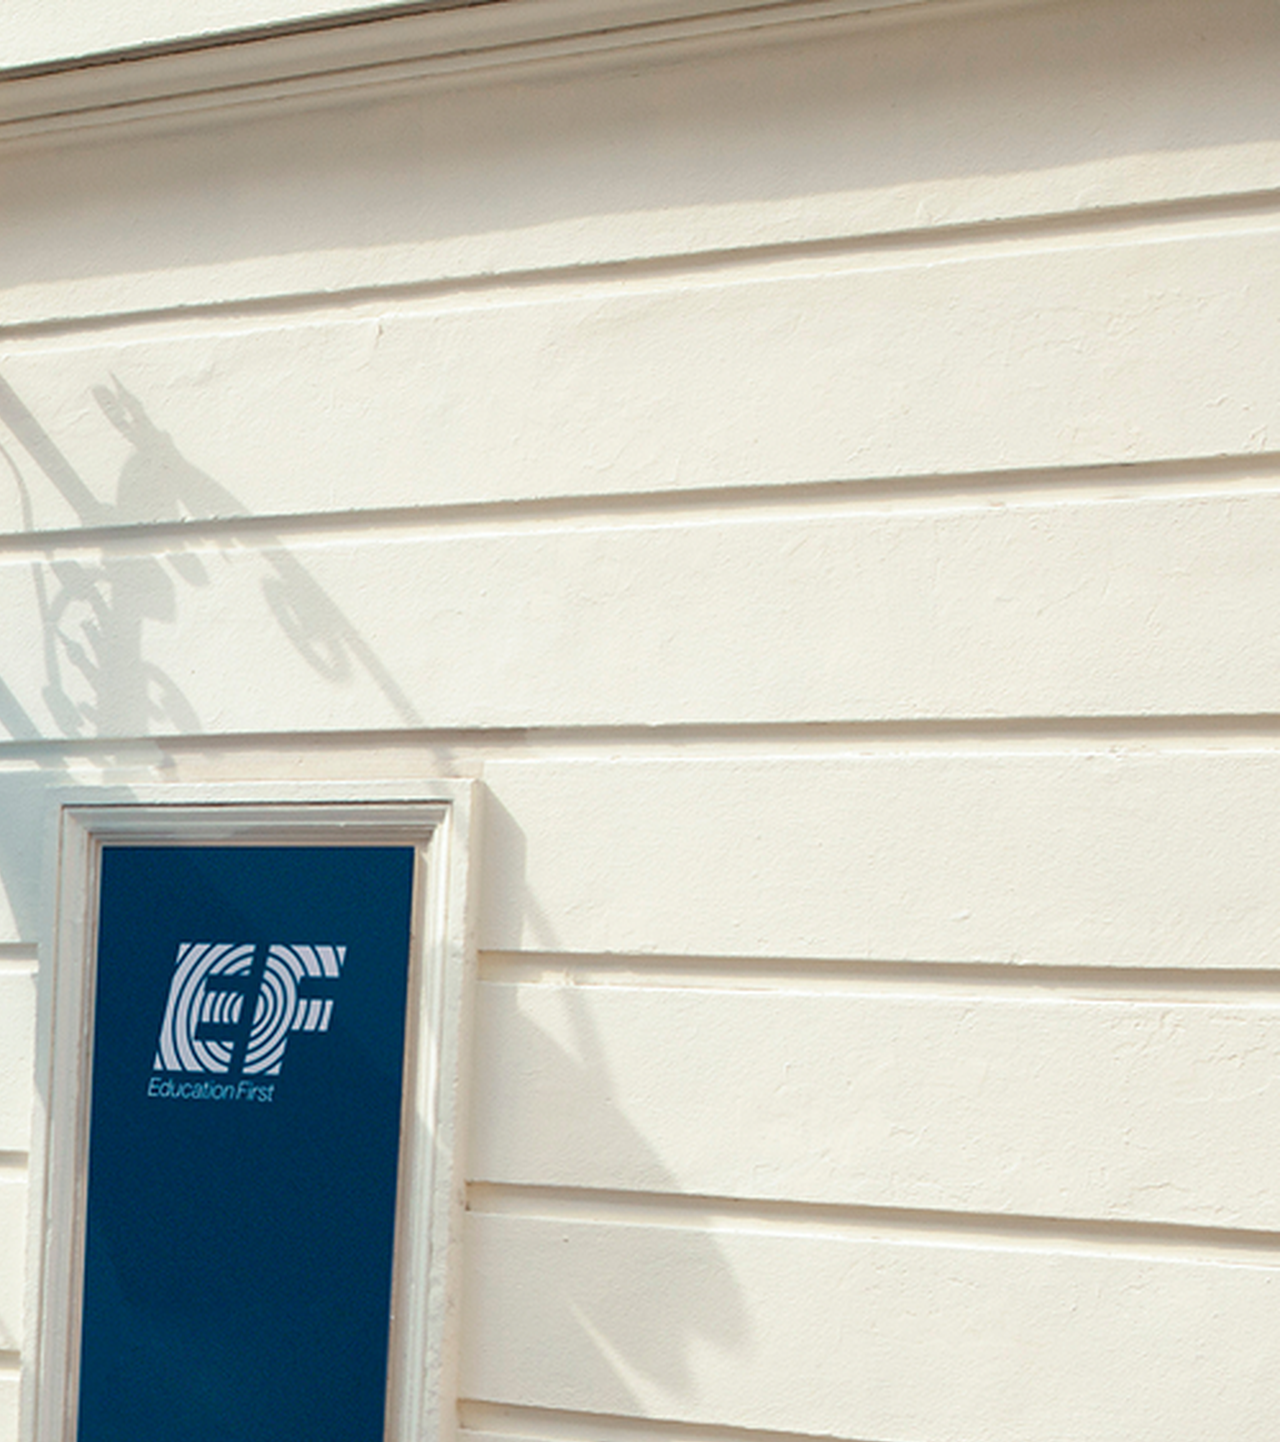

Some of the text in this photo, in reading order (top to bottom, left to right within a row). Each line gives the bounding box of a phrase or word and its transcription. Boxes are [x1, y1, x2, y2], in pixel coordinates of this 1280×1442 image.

[152, 943, 347, 1076] EF
[147, 1077, 275, 1102] Education First
